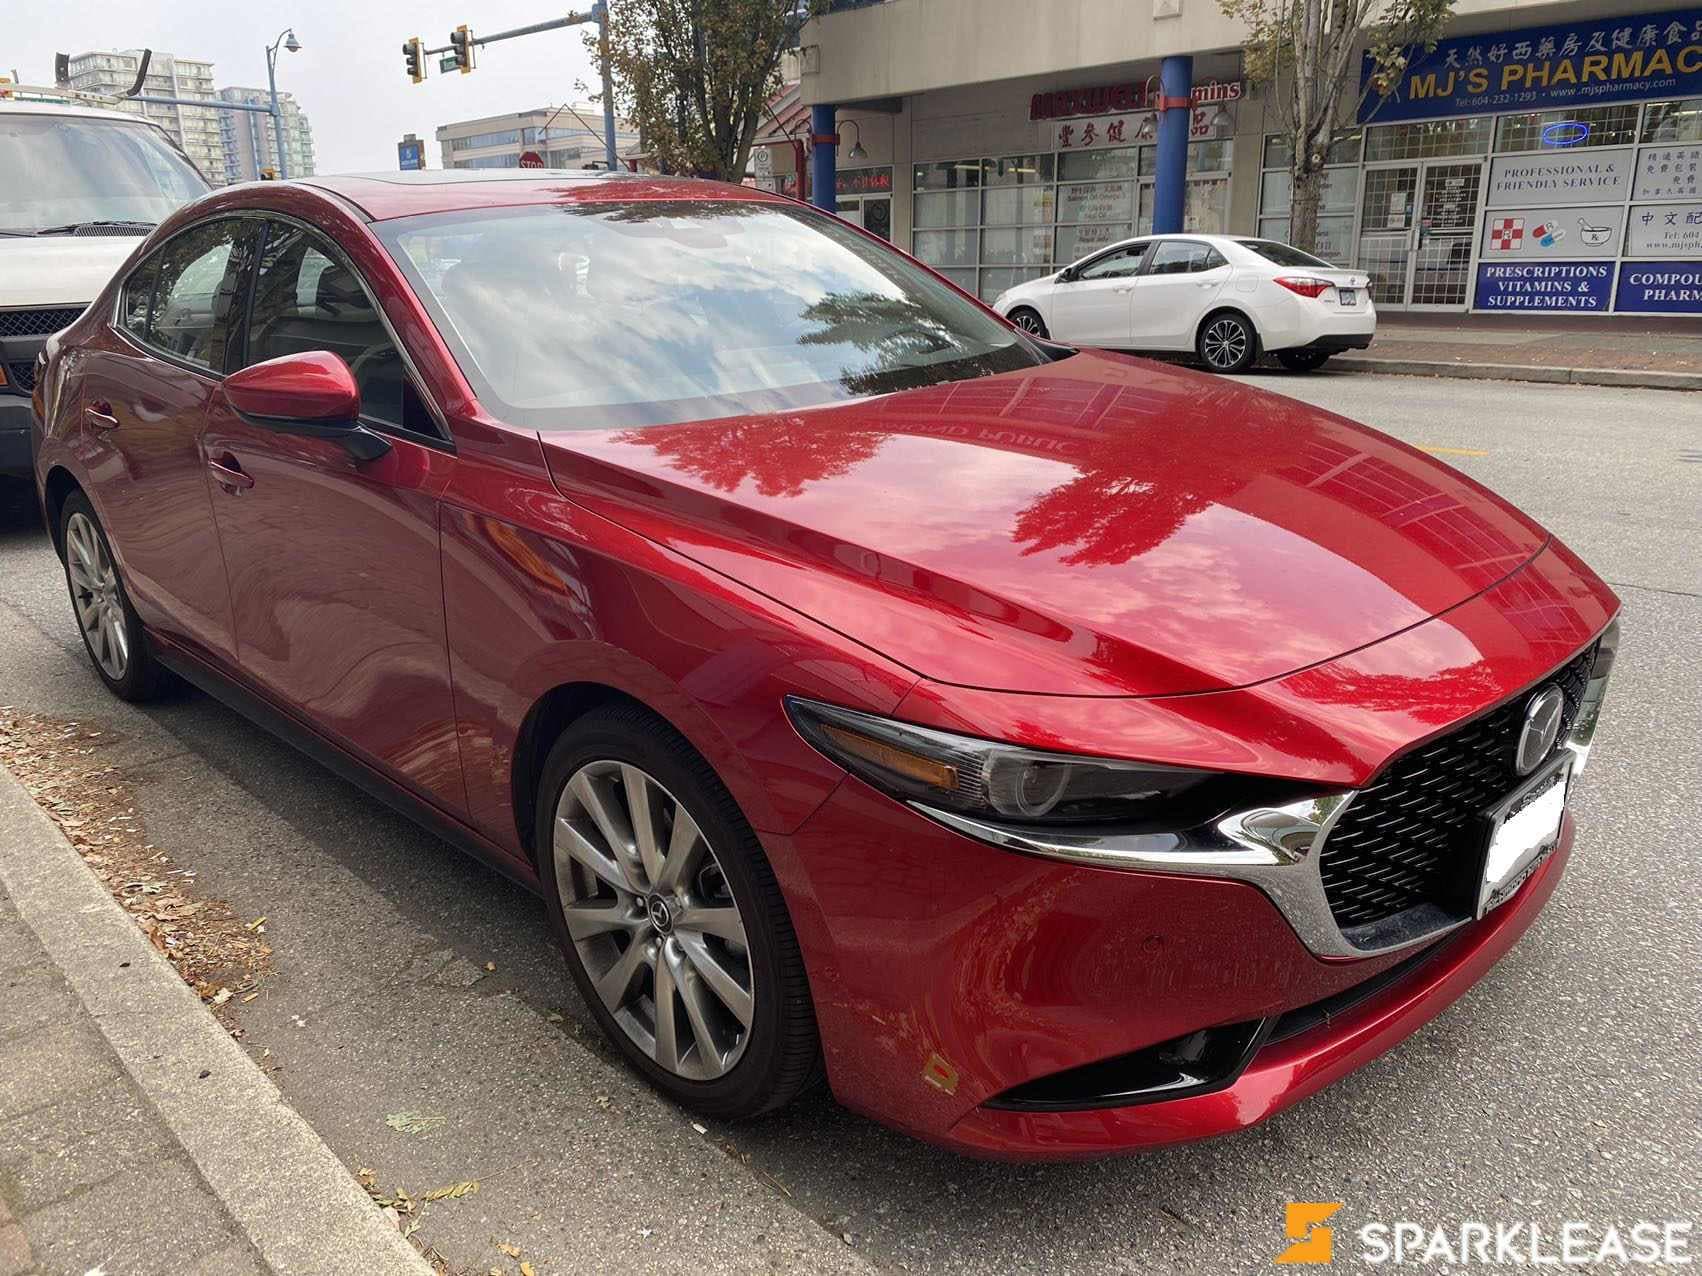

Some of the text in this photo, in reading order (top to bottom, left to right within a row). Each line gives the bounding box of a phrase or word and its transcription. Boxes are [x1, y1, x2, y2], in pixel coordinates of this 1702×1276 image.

[520, 160, 543, 169] STOP
[1504, 163, 1615, 178] PROFESSIONAL &
[1496, 176, 1621, 191] FRIENDLY SERVICE
[1486, 266, 1608, 278] PRESCRIPTIONS
[1498, 281, 1590, 292] VITAMINS &
[1487, 296, 1598, 308] SUPPLEMENTS
